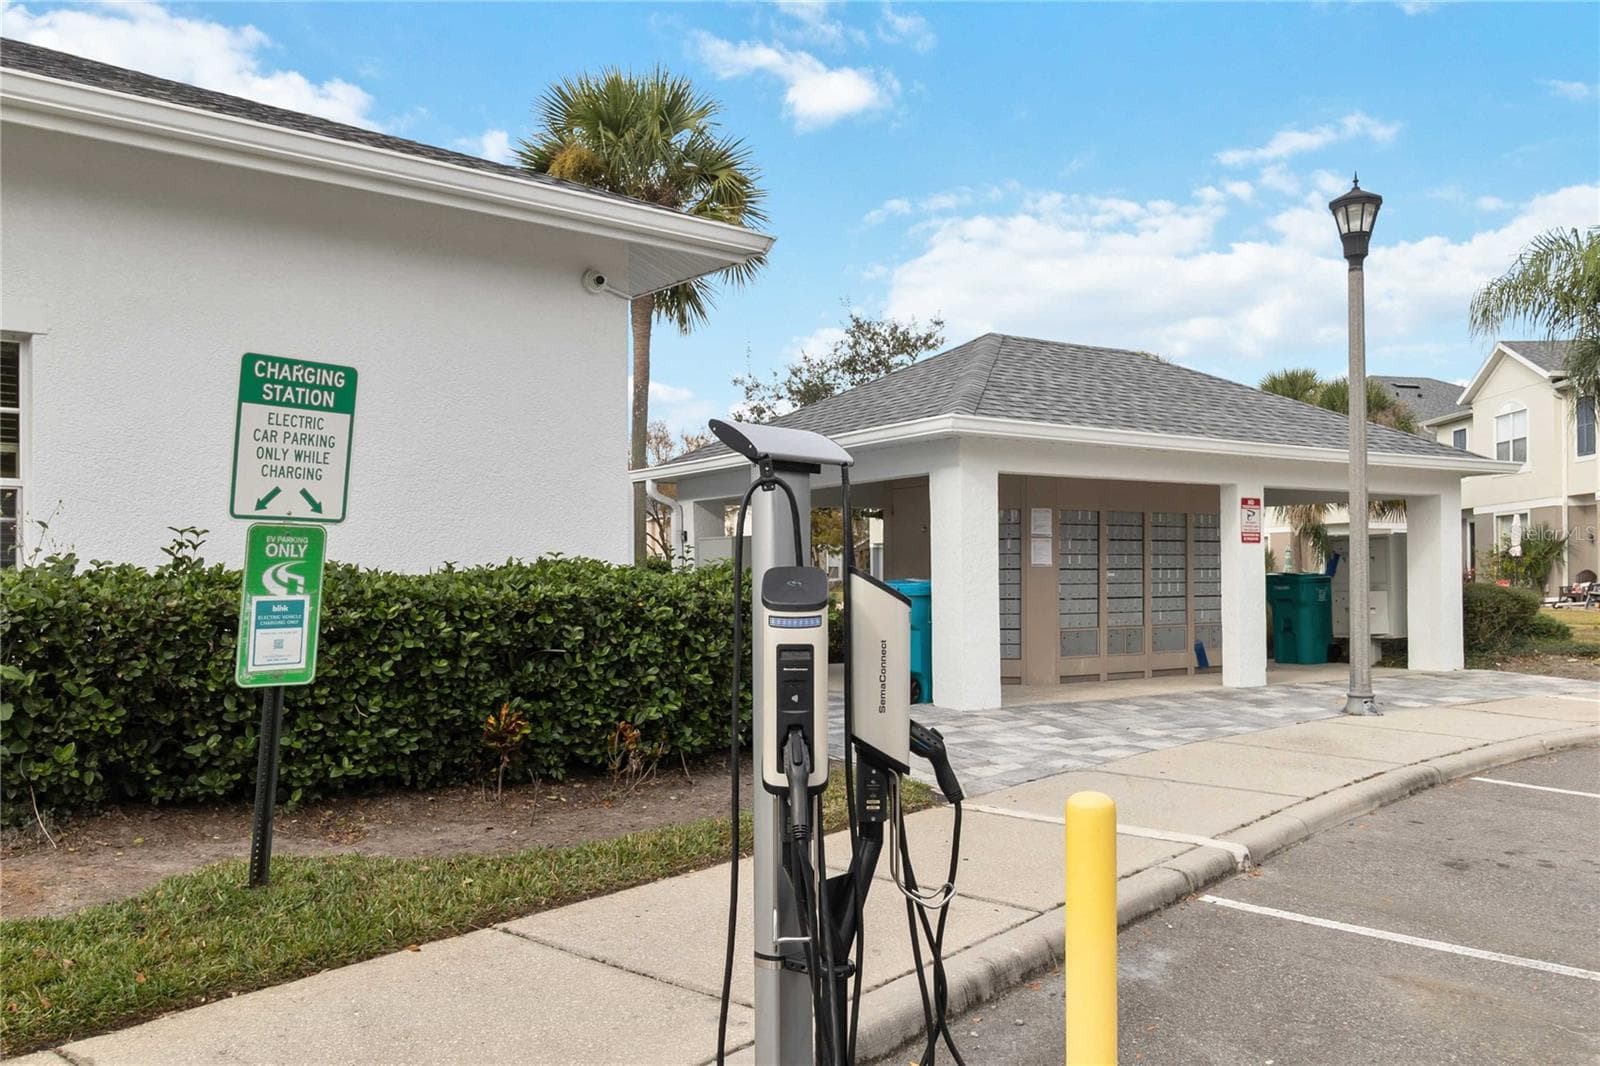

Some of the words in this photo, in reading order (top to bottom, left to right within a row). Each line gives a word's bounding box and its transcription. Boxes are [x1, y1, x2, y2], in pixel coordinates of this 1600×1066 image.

[254, 360, 345, 388] CHARGING
[262, 384, 335, 408] STATION
[268, 412, 325, 430] ELECTRIC
[253, 428, 278, 443] CAR
[283, 431, 336, 449] PARKING
[256, 446, 289, 461] ONLY
[294, 450, 331, 465] WHILE
[261, 464, 324, 481] CHARGING
[266, 535, 276, 543] EV
[277, 536, 309, 544] PARKING
[265, 542, 309, 558] ONLY
[879, 639, 887, 714] SemaConnect
